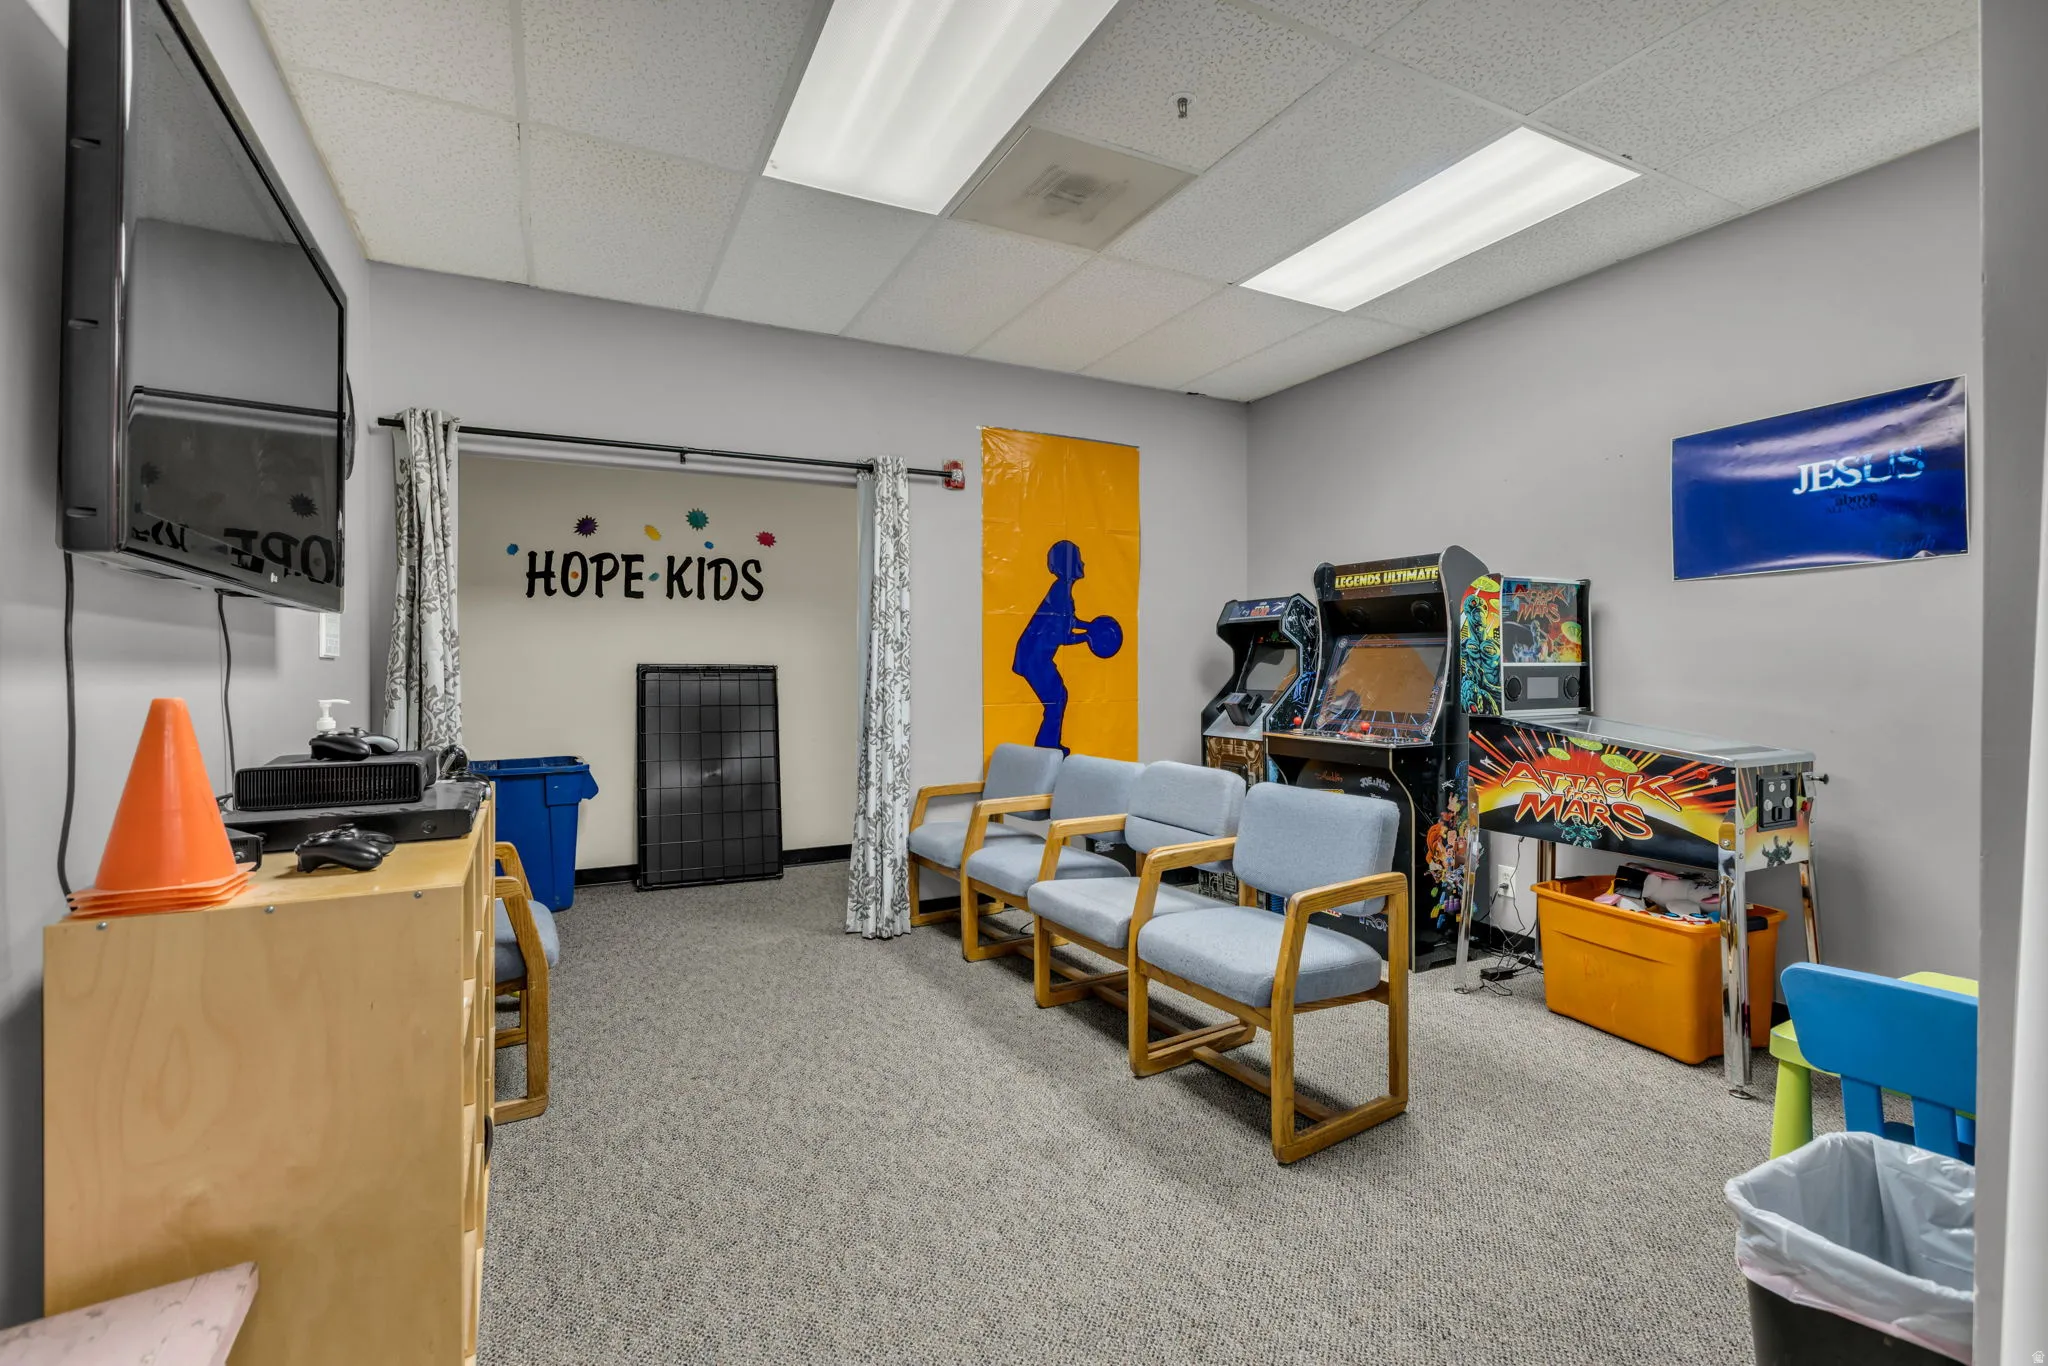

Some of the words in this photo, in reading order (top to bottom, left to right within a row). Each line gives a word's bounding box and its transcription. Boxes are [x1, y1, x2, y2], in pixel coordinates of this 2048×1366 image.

[1793, 446, 1924, 495] JESUS
[526, 550, 644, 599] HOPE
[666, 555, 765, 602] KIDS
[1334, 573, 1381, 589] LEGENDS
[1383, 566, 1439, 584] ULTIMATE
[1516, 602, 1561, 623] MARS
[1501, 760, 1681, 812] ATTACK
[1566, 788, 1606, 804] from
[1515, 792, 1654, 840] MARS
